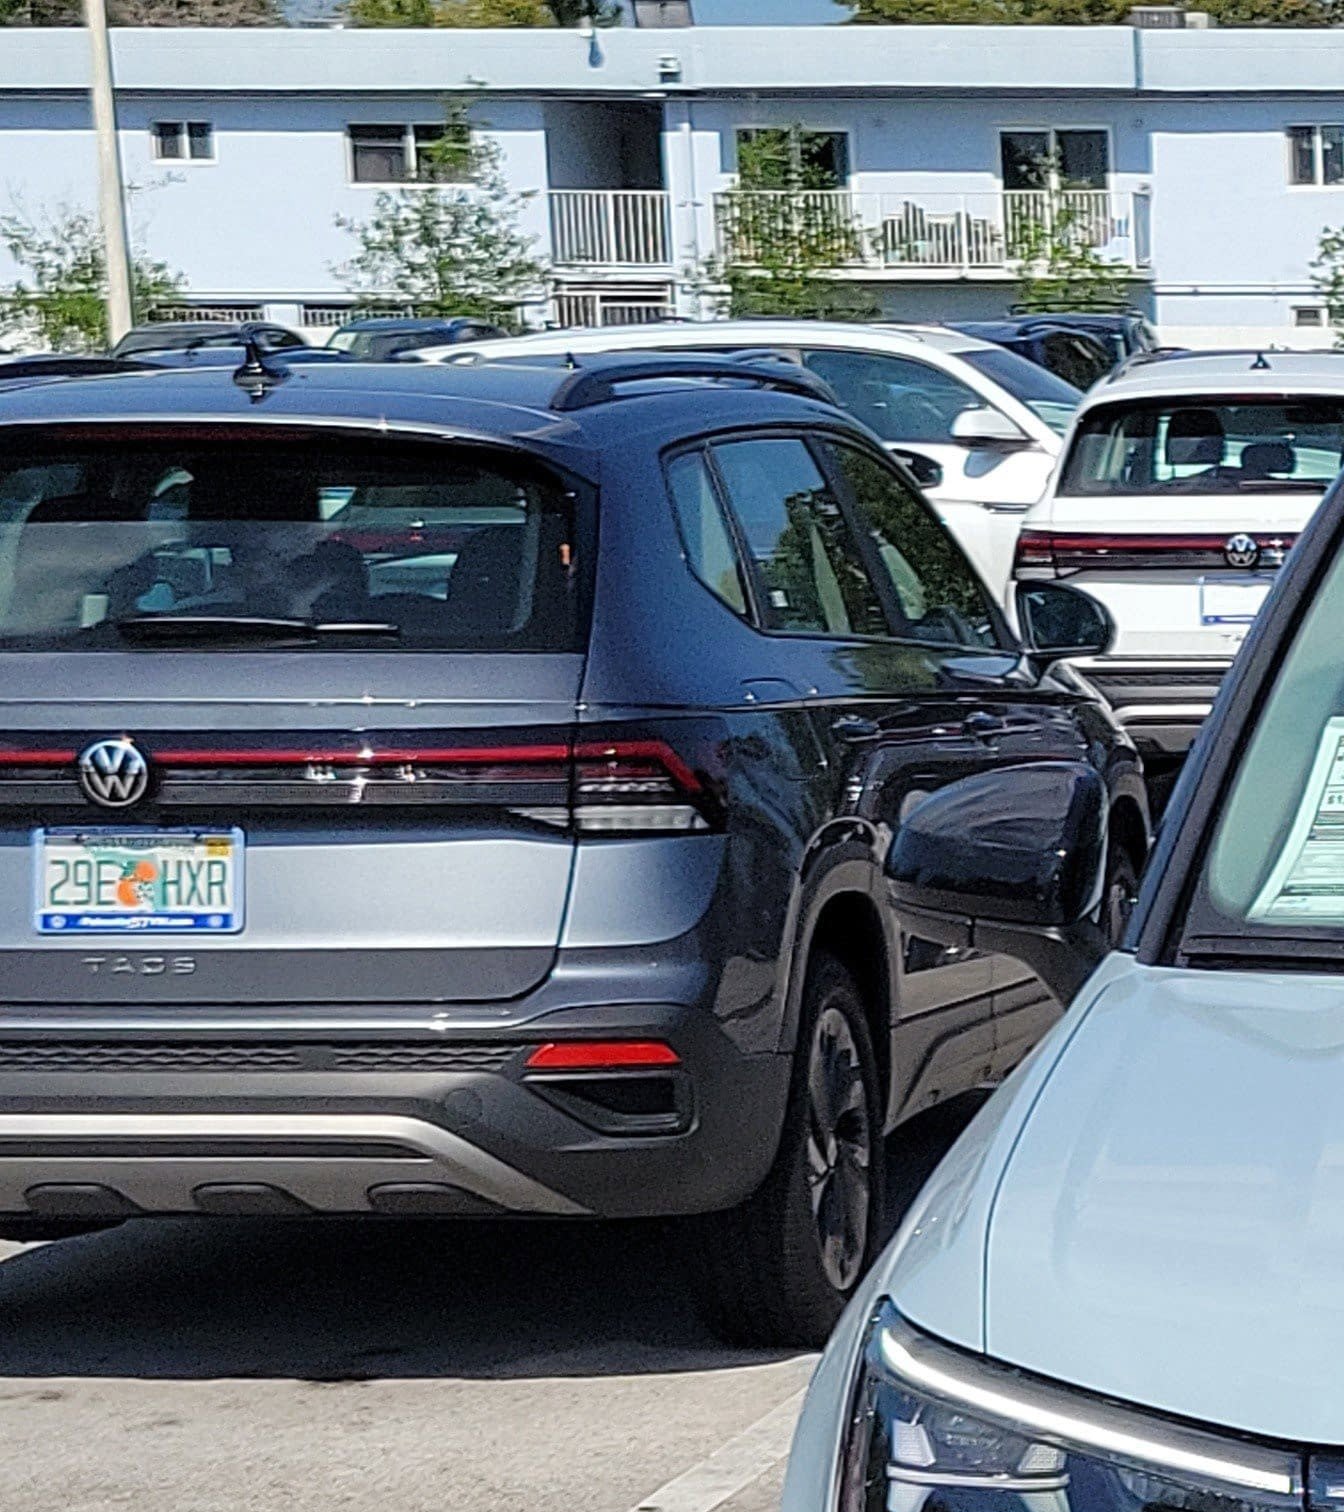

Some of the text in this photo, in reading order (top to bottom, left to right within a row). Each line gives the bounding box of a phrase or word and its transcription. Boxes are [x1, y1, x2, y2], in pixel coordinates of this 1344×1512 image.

[1227, 535, 1256, 565] VW
[83, 743, 144, 802] VW
[50, 860, 227, 906] 29E HXR
